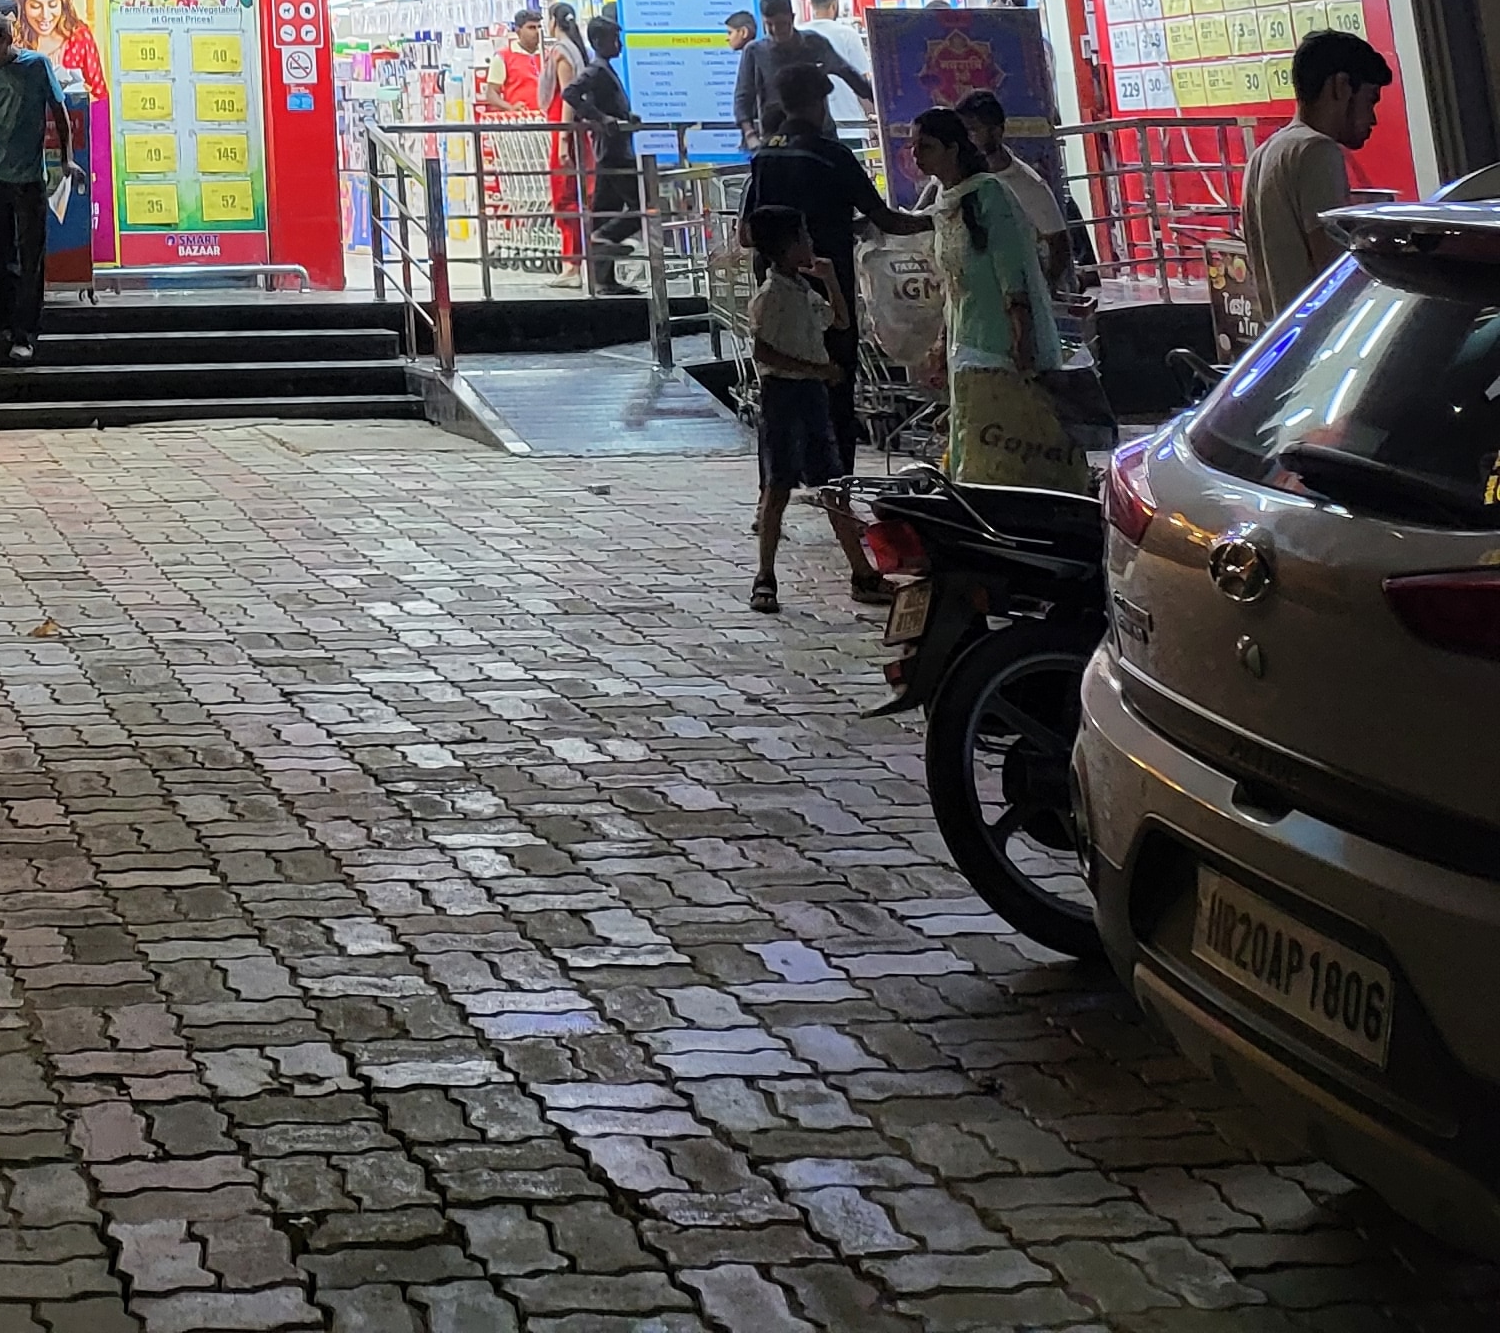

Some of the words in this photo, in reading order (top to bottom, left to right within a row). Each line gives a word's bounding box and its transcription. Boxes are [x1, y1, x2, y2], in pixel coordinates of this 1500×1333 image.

[161, 15, 183, 23] Great
[185, 15, 213, 23] Prices!
[1336, 13, 1361, 30] 108
[1270, 21, 1285, 38] 50
[140, 47, 156, 61] 99
[213, 50, 227, 63] 40
[1148, 78, 1161, 92] 30
[1244, 73, 1260, 90] 30
[1121, 82, 1140, 98] 229
[141, 97, 156, 110] 29
[214, 99, 235, 113] 149
[146, 148, 161, 162] 49
[217, 147, 237, 162] 145
[147, 199, 163, 213] 35
[221, 195, 236, 208] 52
[179, 235, 218, 245] SMART
[178, 245, 221, 257] BAZAAR
[894, 263, 921, 272] TATA
[1222, 292, 1252, 317] Taste
